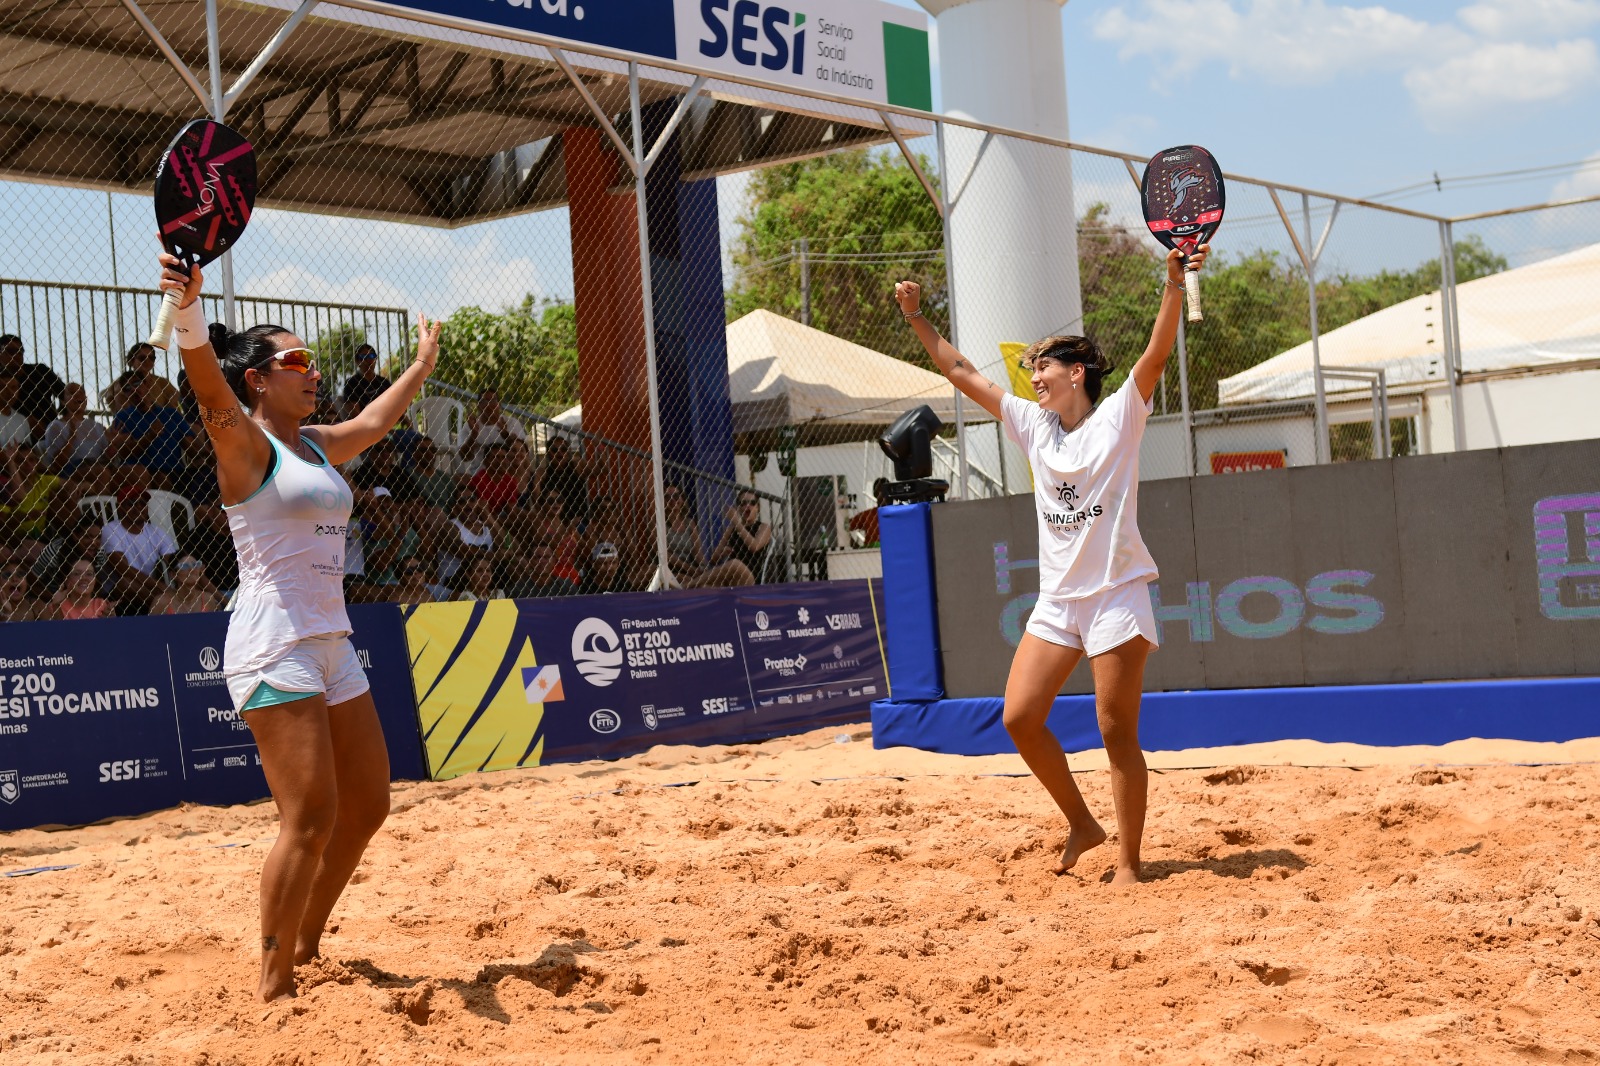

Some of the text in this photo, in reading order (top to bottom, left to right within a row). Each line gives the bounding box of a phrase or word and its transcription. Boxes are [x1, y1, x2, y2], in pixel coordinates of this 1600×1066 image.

[818, 18, 854, 41] Serviço
[817, 41, 846, 62] Social
[816, 65, 873, 90] da Indústria
[1051, 520, 1092, 532] PORS
[635, 618, 657, 629] Beach
[657, 616, 680, 627] Tennis
[623, 630, 671, 650] BT 200
[786, 627, 826, 638] TRANSCARE
[0, 653, 74, 669] Beach Tennis
[627, 642, 735, 667] SESI TOCANTINS
[763, 656, 794, 671] Pronto
[185, 671, 226, 682] UMUARA
[630, 669, 657, 679] Palmas
[778, 668, 796, 677] FIBRA
[11, 672, 56, 695] 200
[33, 688, 160, 716] TOCANTINS
[21, 772, 67, 783] CONFEDERAÇÃO
